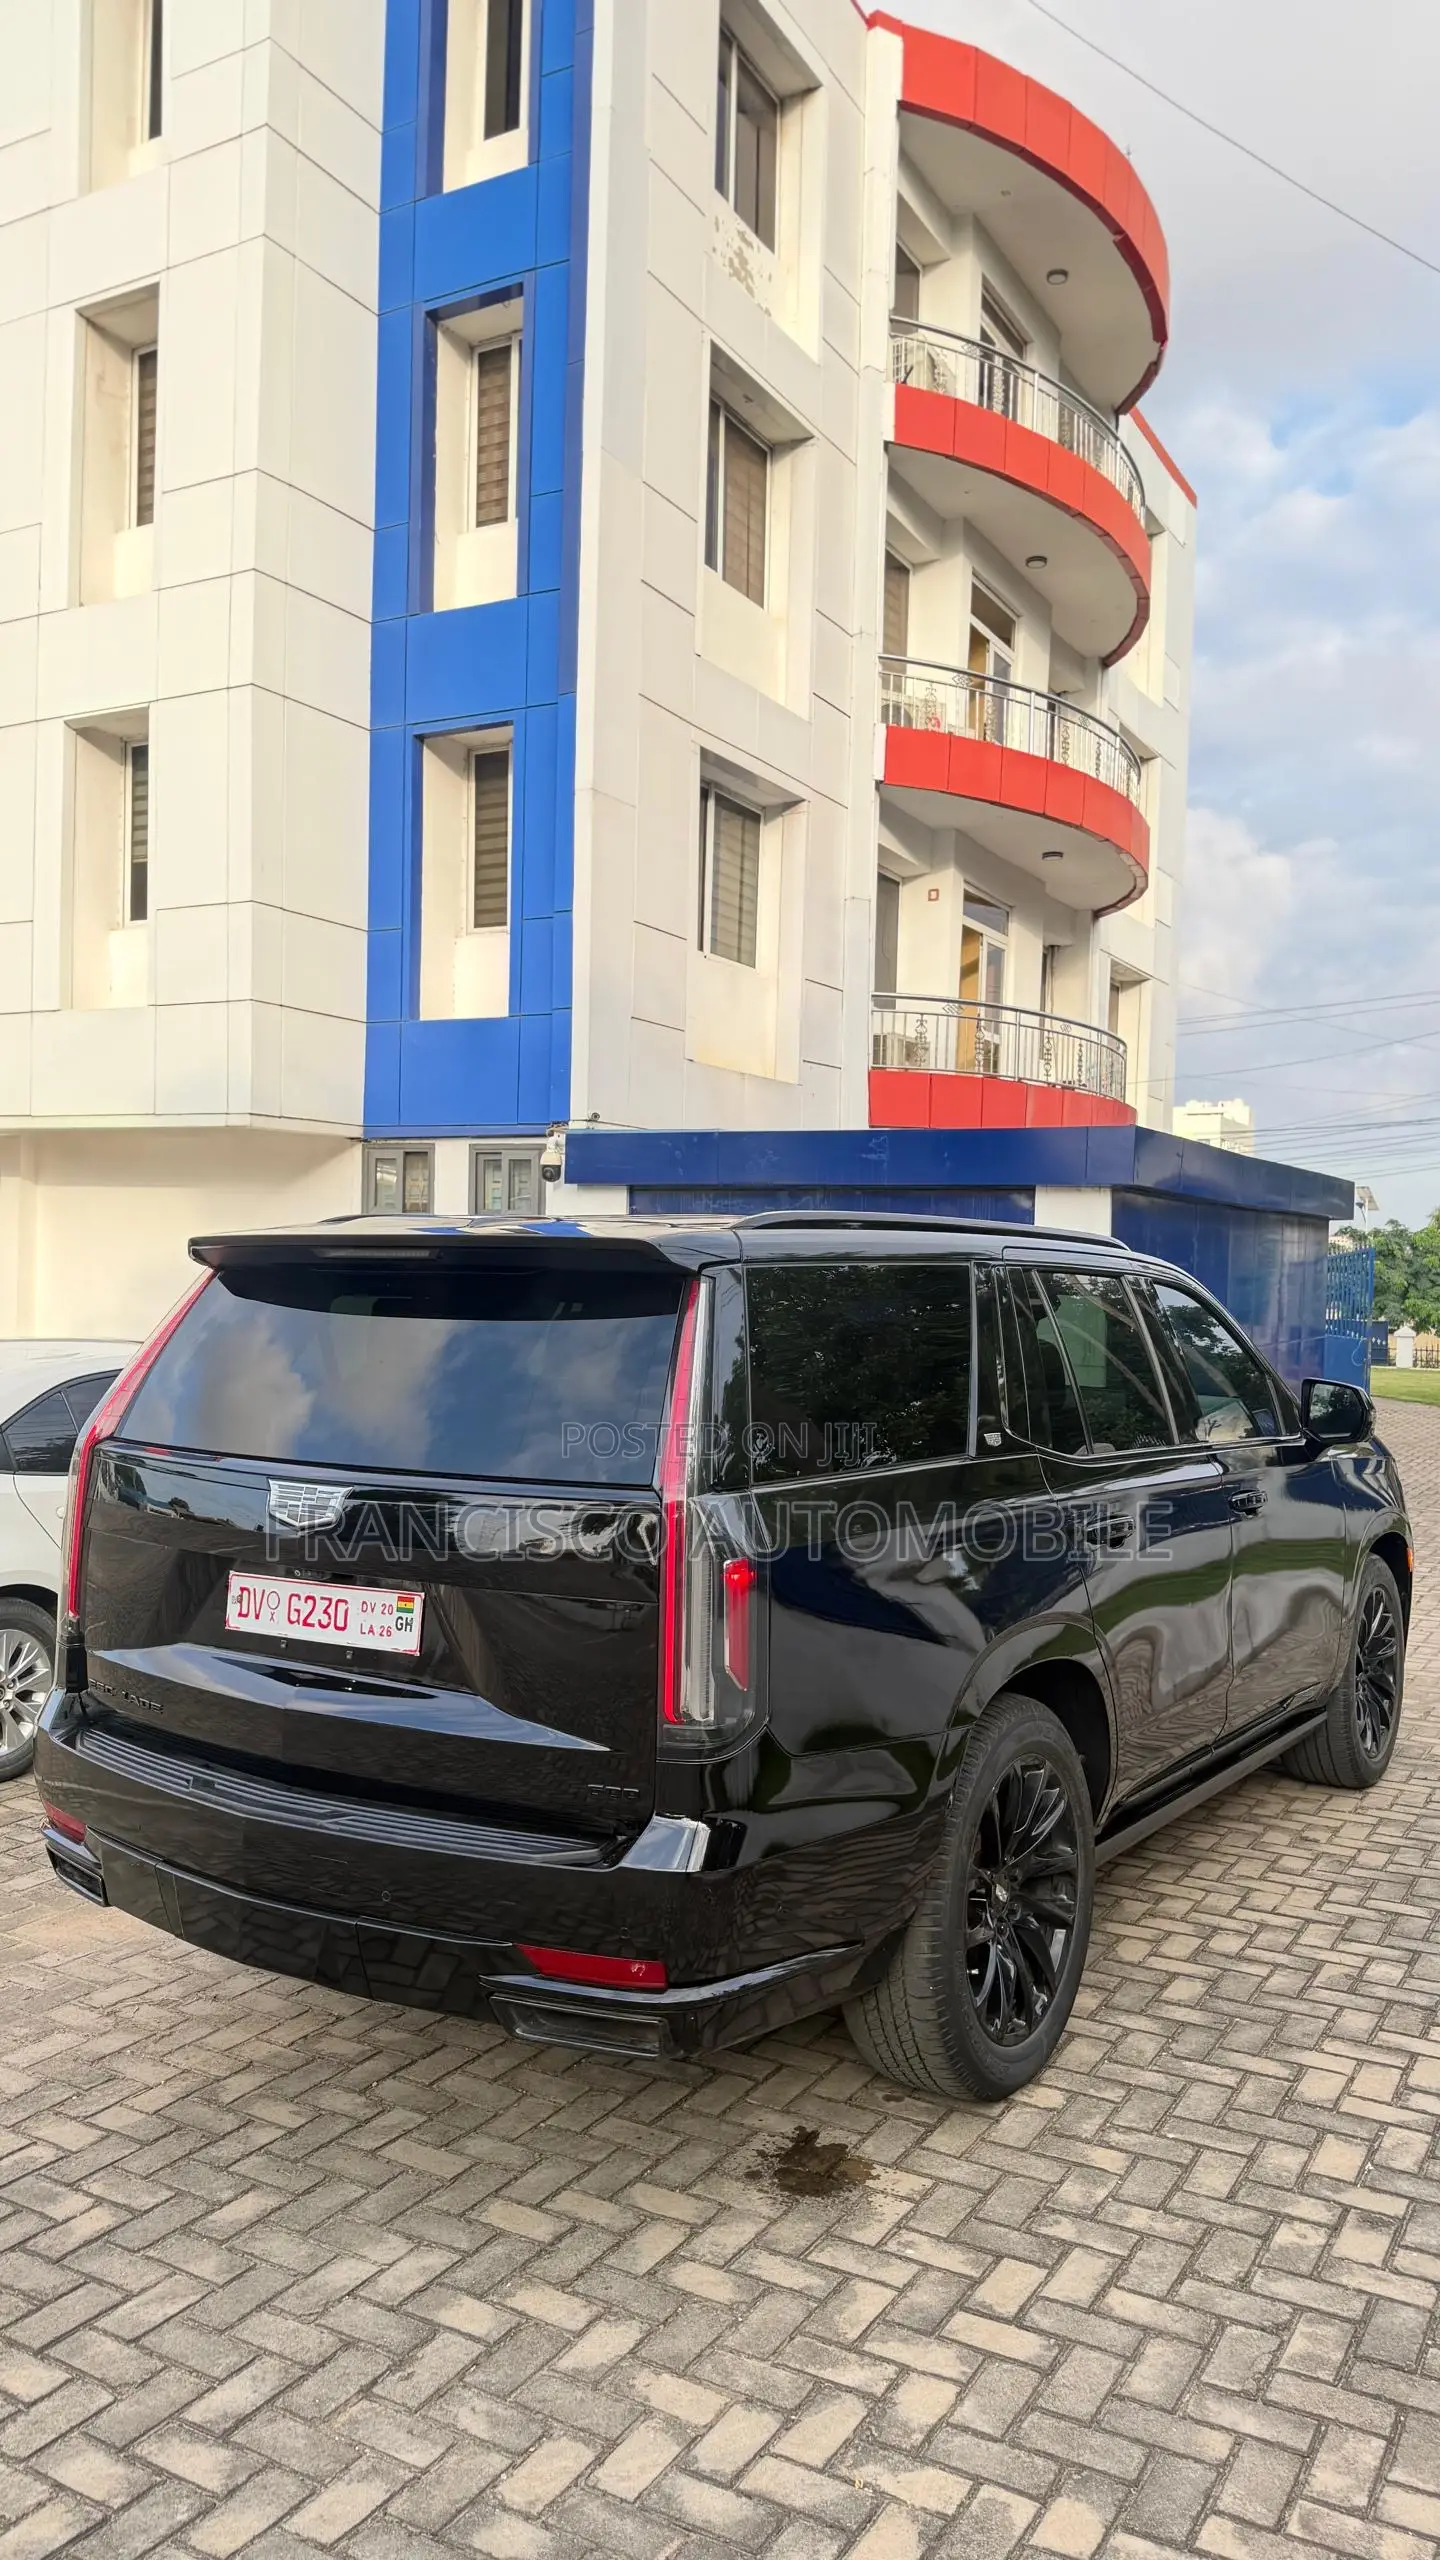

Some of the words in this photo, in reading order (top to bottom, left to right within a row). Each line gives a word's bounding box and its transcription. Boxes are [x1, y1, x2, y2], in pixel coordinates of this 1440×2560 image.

[238, 1586, 265, 1620] DV
[287, 1593, 349, 1632] G230
[361, 1600, 377, 1614] DV
[381, 1603, 394, 1616] 20
[360, 1622, 375, 1636] LA
[379, 1625, 392, 1638] 26
[395, 1616, 414, 1633] GH
[87, 1677, 164, 1714] ESCLADE
